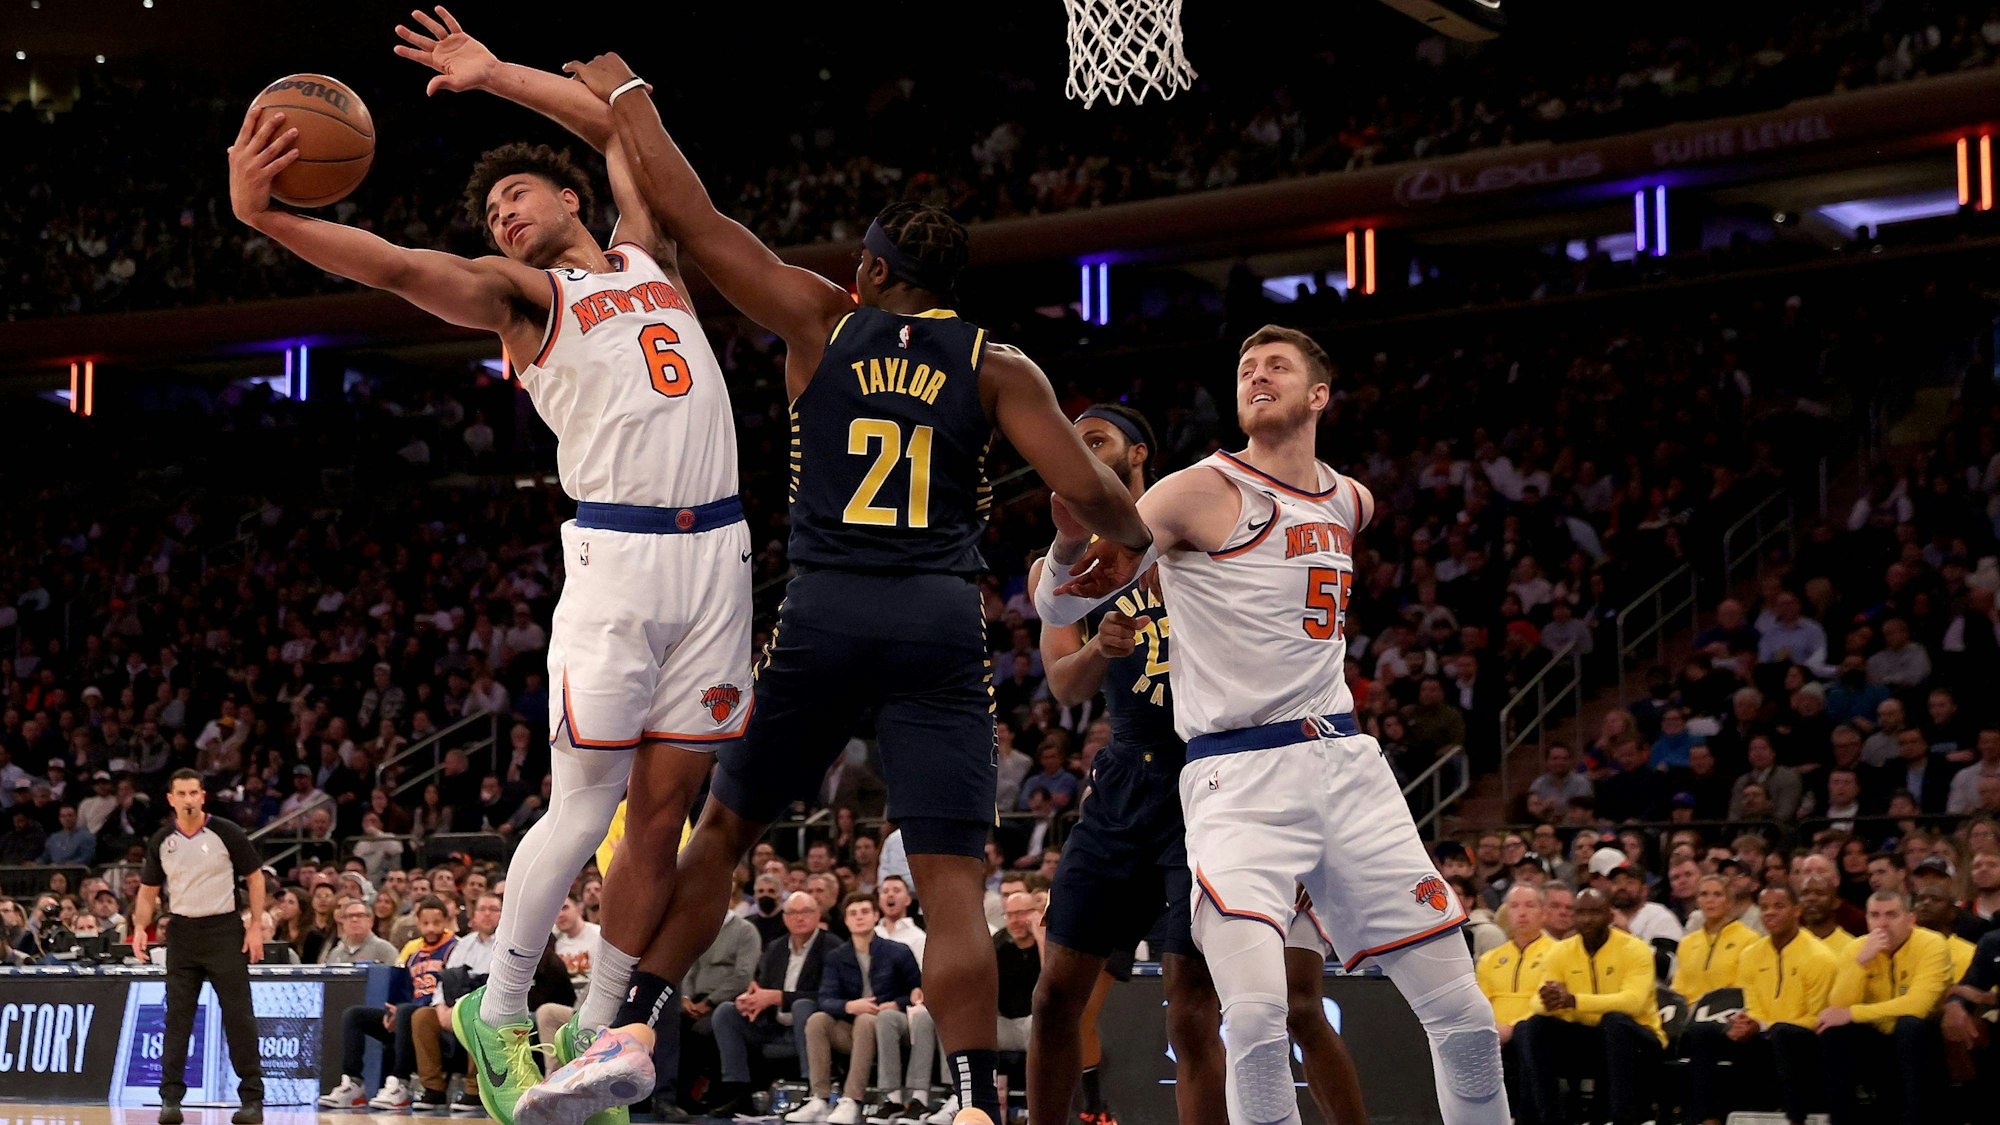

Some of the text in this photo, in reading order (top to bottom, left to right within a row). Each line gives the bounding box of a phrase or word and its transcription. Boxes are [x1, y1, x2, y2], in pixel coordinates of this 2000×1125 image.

[265, 81, 350, 115] Wilson
[1651, 114, 1832, 166] SUITE LEVEL
[1450, 152, 1603, 194] LEXUS
[570, 289, 635, 336] NEW
[637, 322, 693, 398] 6
[851, 357, 946, 405] TAYLOR
[842, 417, 933, 528] 21
[1285, 522, 1330, 560] NEW
[0, 1003, 95, 1073] CTORY
[258, 1036, 300, 1058] 1800
